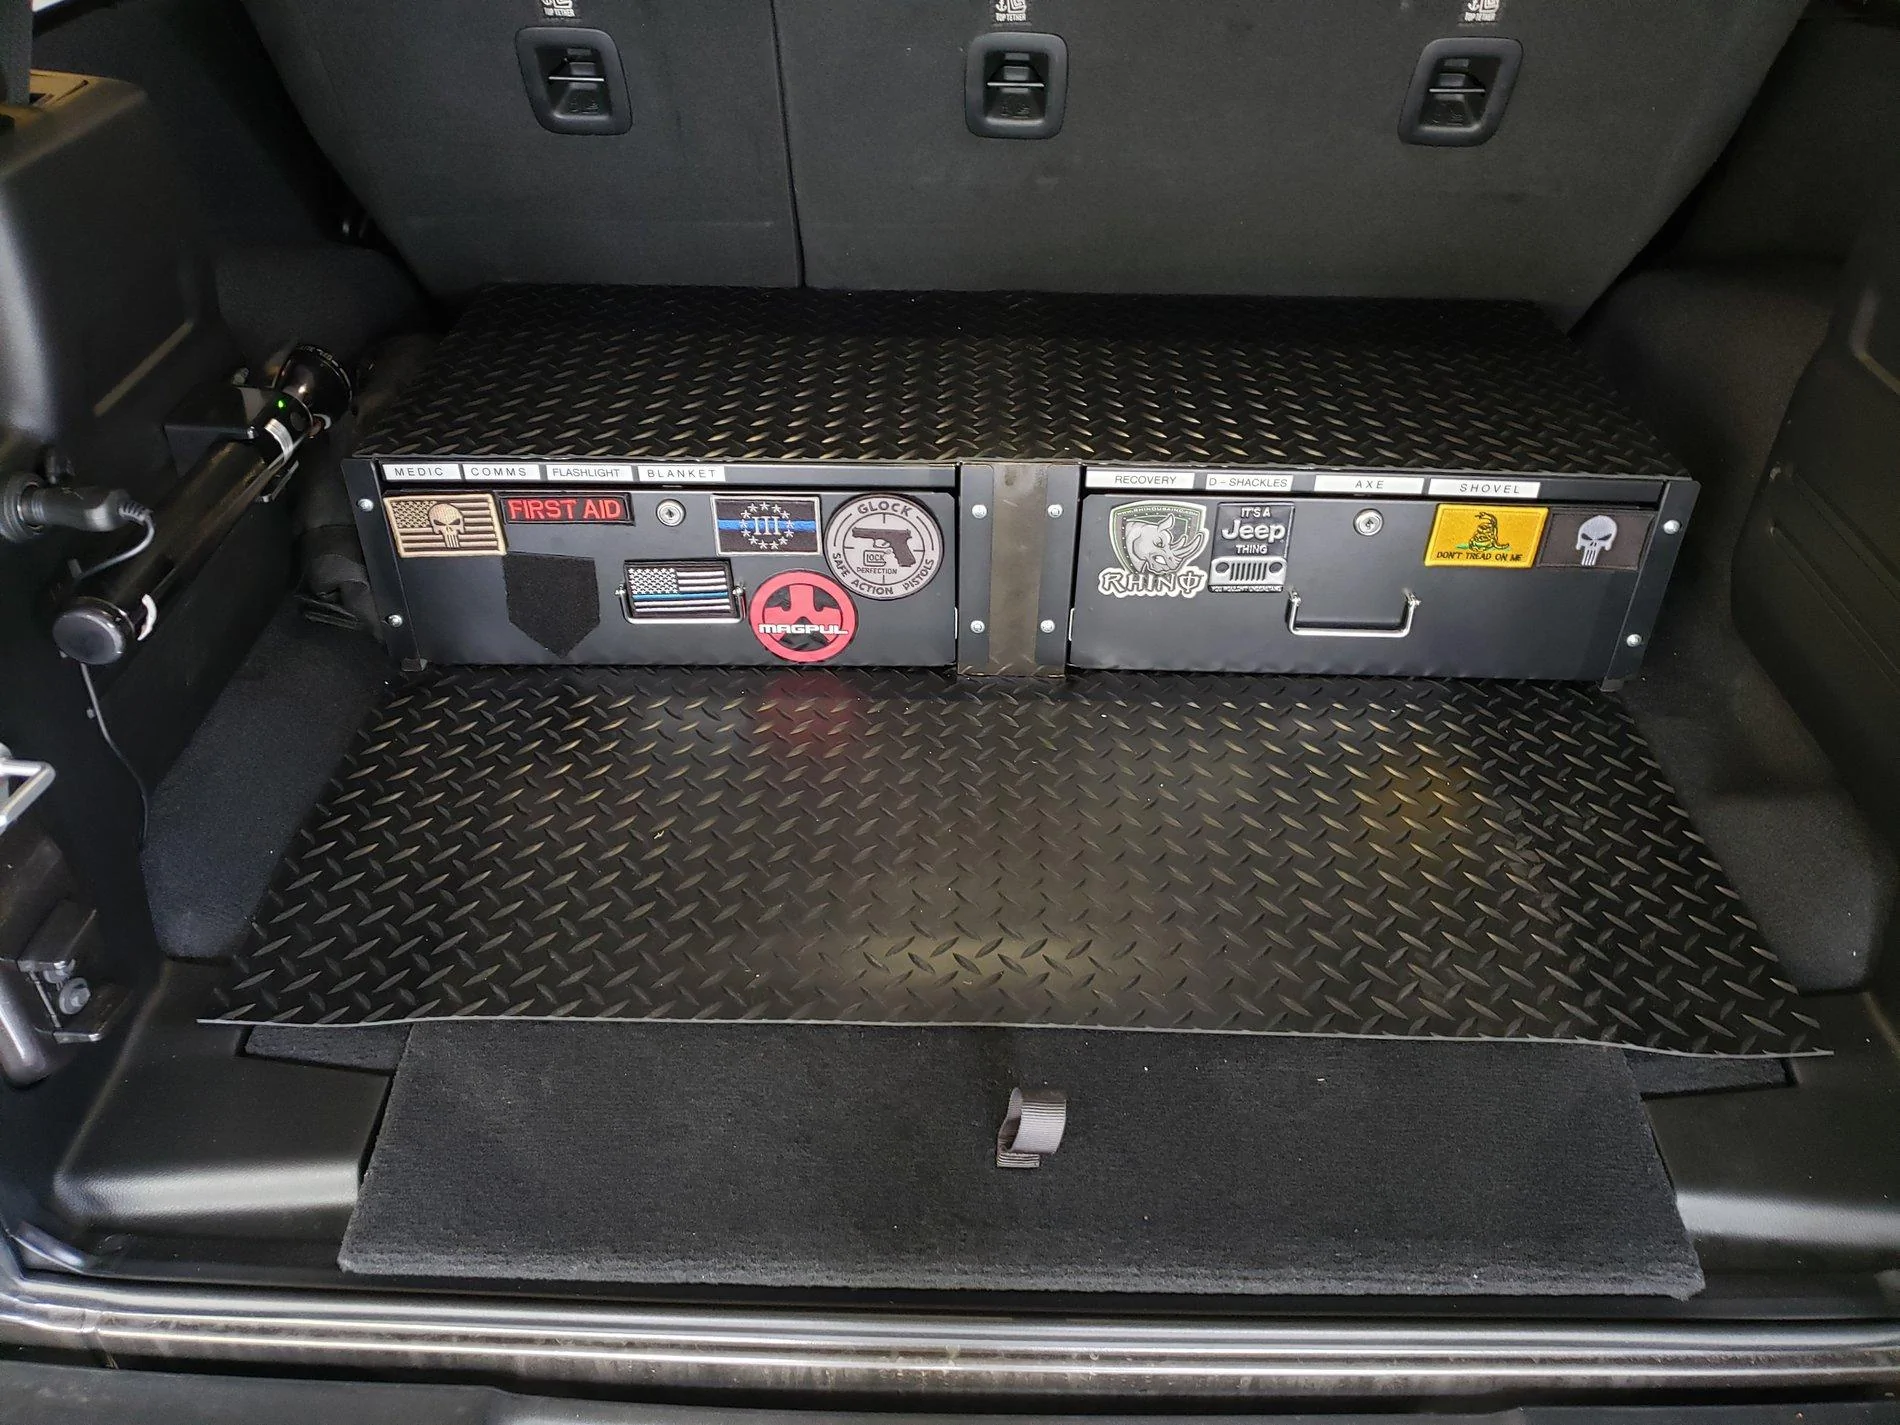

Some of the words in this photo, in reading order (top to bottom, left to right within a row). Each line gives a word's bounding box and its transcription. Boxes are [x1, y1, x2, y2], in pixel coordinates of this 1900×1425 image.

[394, 466, 444, 477] MEDIC
[470, 466, 528, 478] COMMS
[552, 467, 621, 478] FLASHLIGHT
[646, 468, 717, 479] BLANKET
[1115, 475, 1177, 485] RECOVERY
[1354, 480, 1385, 489] AXE
[1459, 483, 1521, 494] SHOVEL
[508, 498, 578, 520] FIRST
[582, 499, 622, 520] AID
[857, 500, 913, 517] GLOCK
[1241, 506, 1261, 518] IT'S
[1262, 506, 1271, 518] A
[1222, 519, 1286, 543] Jeep
[1236, 544, 1268, 554] THING
[1465, 552, 1492, 560] TREAD
[1494, 553, 1508, 561] ON
[832, 552, 851, 578] SAFE
[851, 579, 894, 595] ACTION
[902, 558, 934, 590] PISTOLS
[1100, 570, 1206, 594] RHINO
[758, 624, 849, 635] MAGPUL
